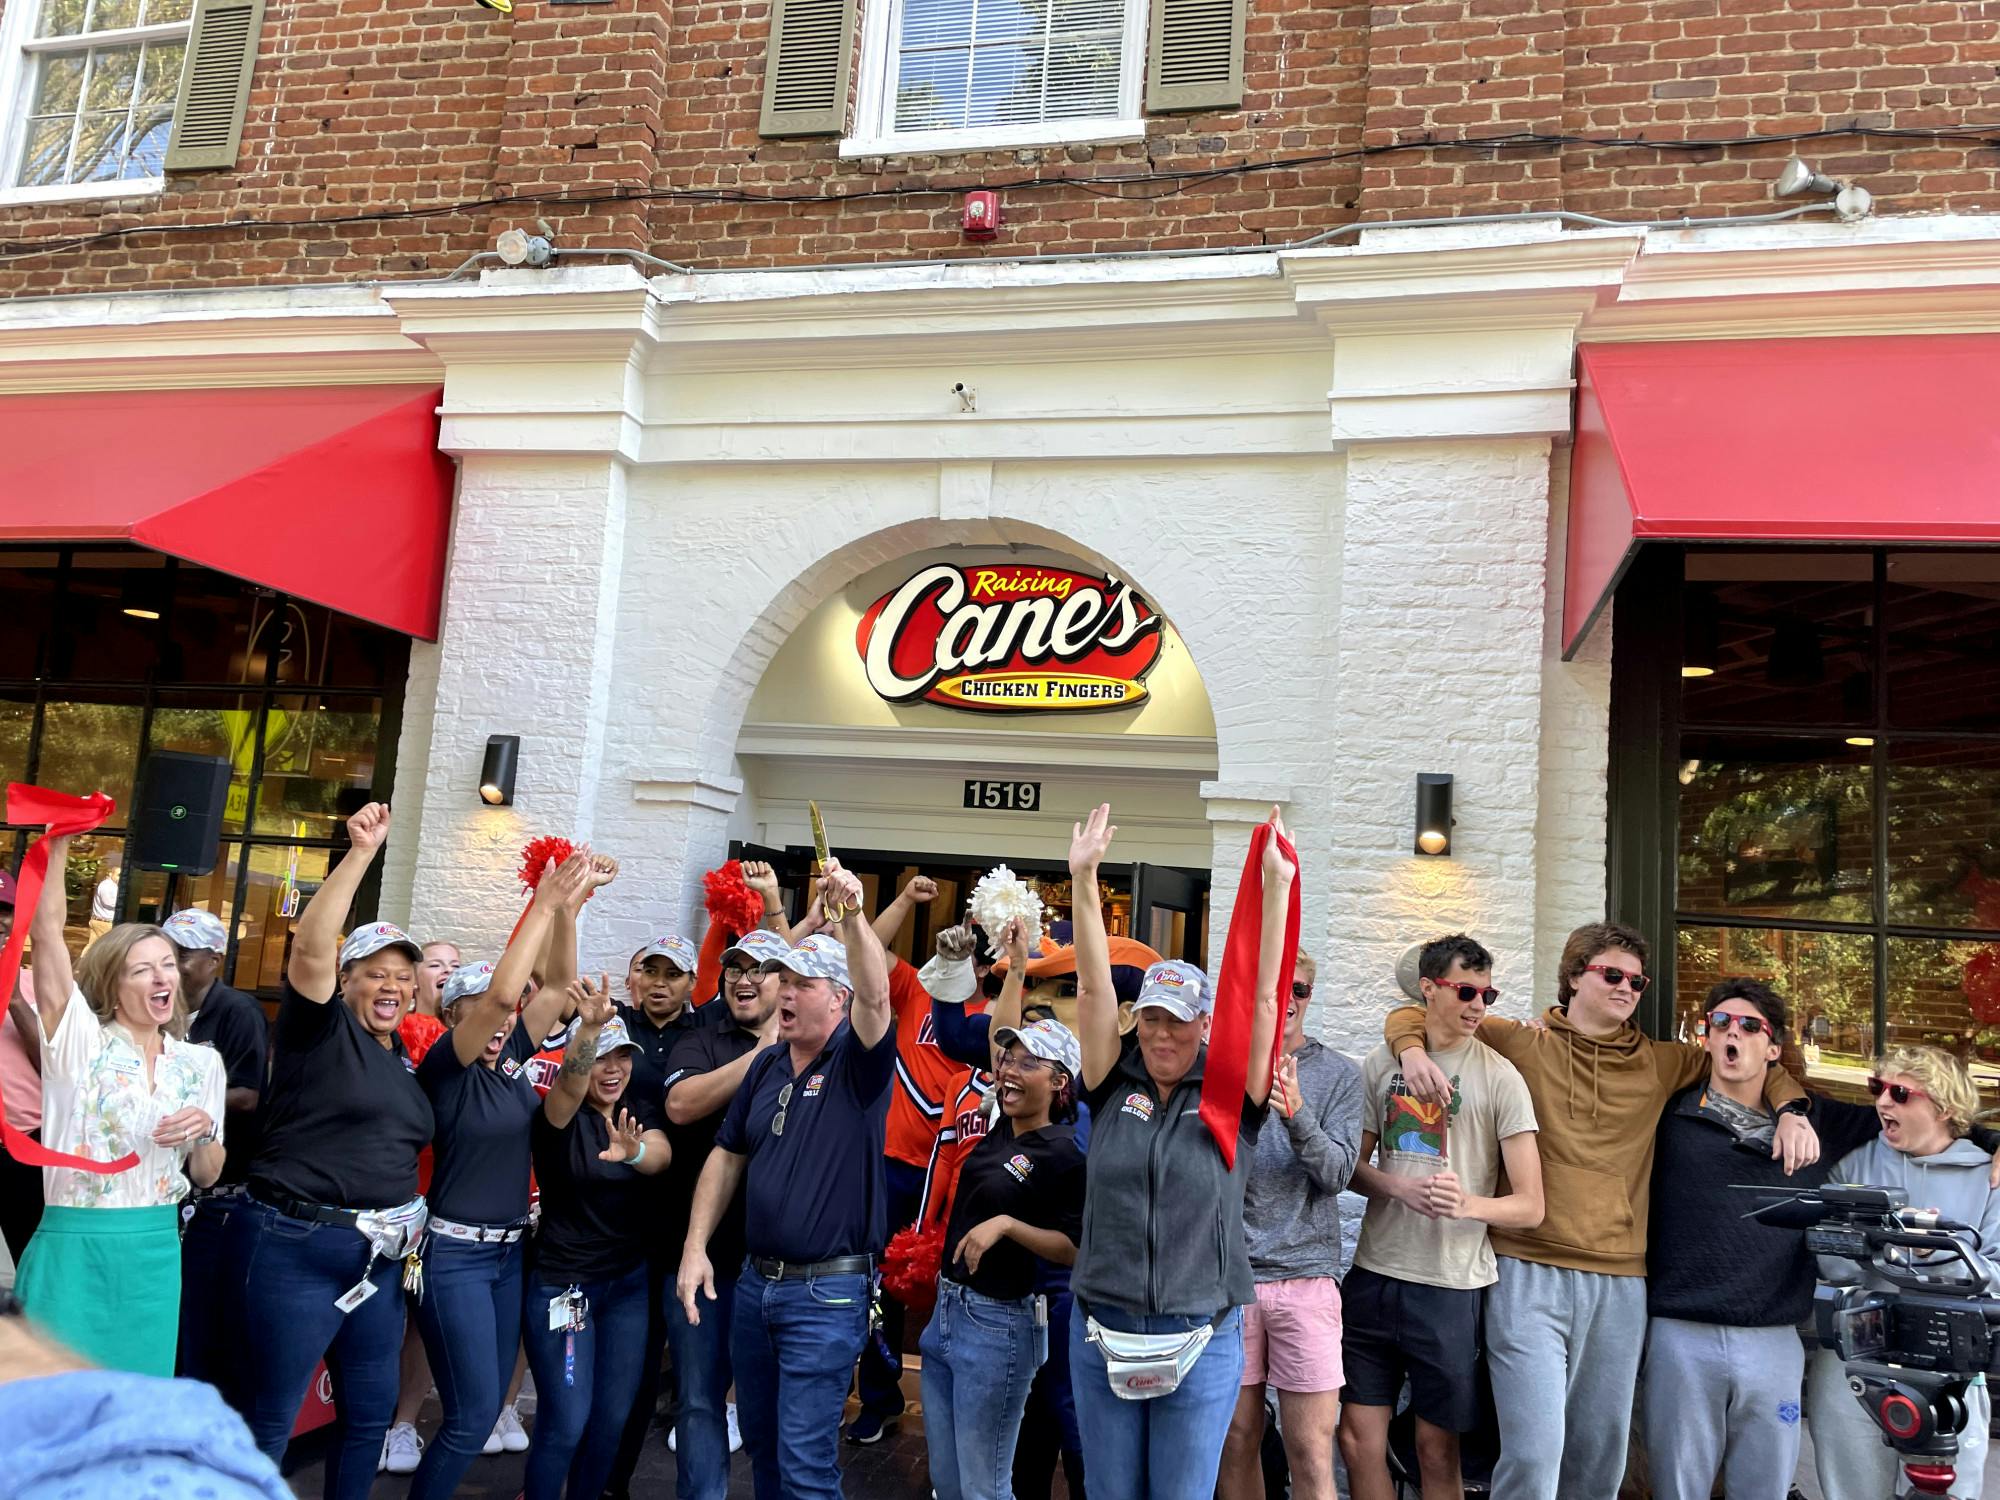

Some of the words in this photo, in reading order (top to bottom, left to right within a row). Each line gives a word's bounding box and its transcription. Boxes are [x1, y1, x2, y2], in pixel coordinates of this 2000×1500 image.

[972, 570, 1072, 599] Raising
[866, 566, 1162, 698] Cane's
[961, 679, 1038, 697] CHICKEN
[1046, 681, 1124, 699] FINGERS
[970, 782, 1035, 809] 1519
